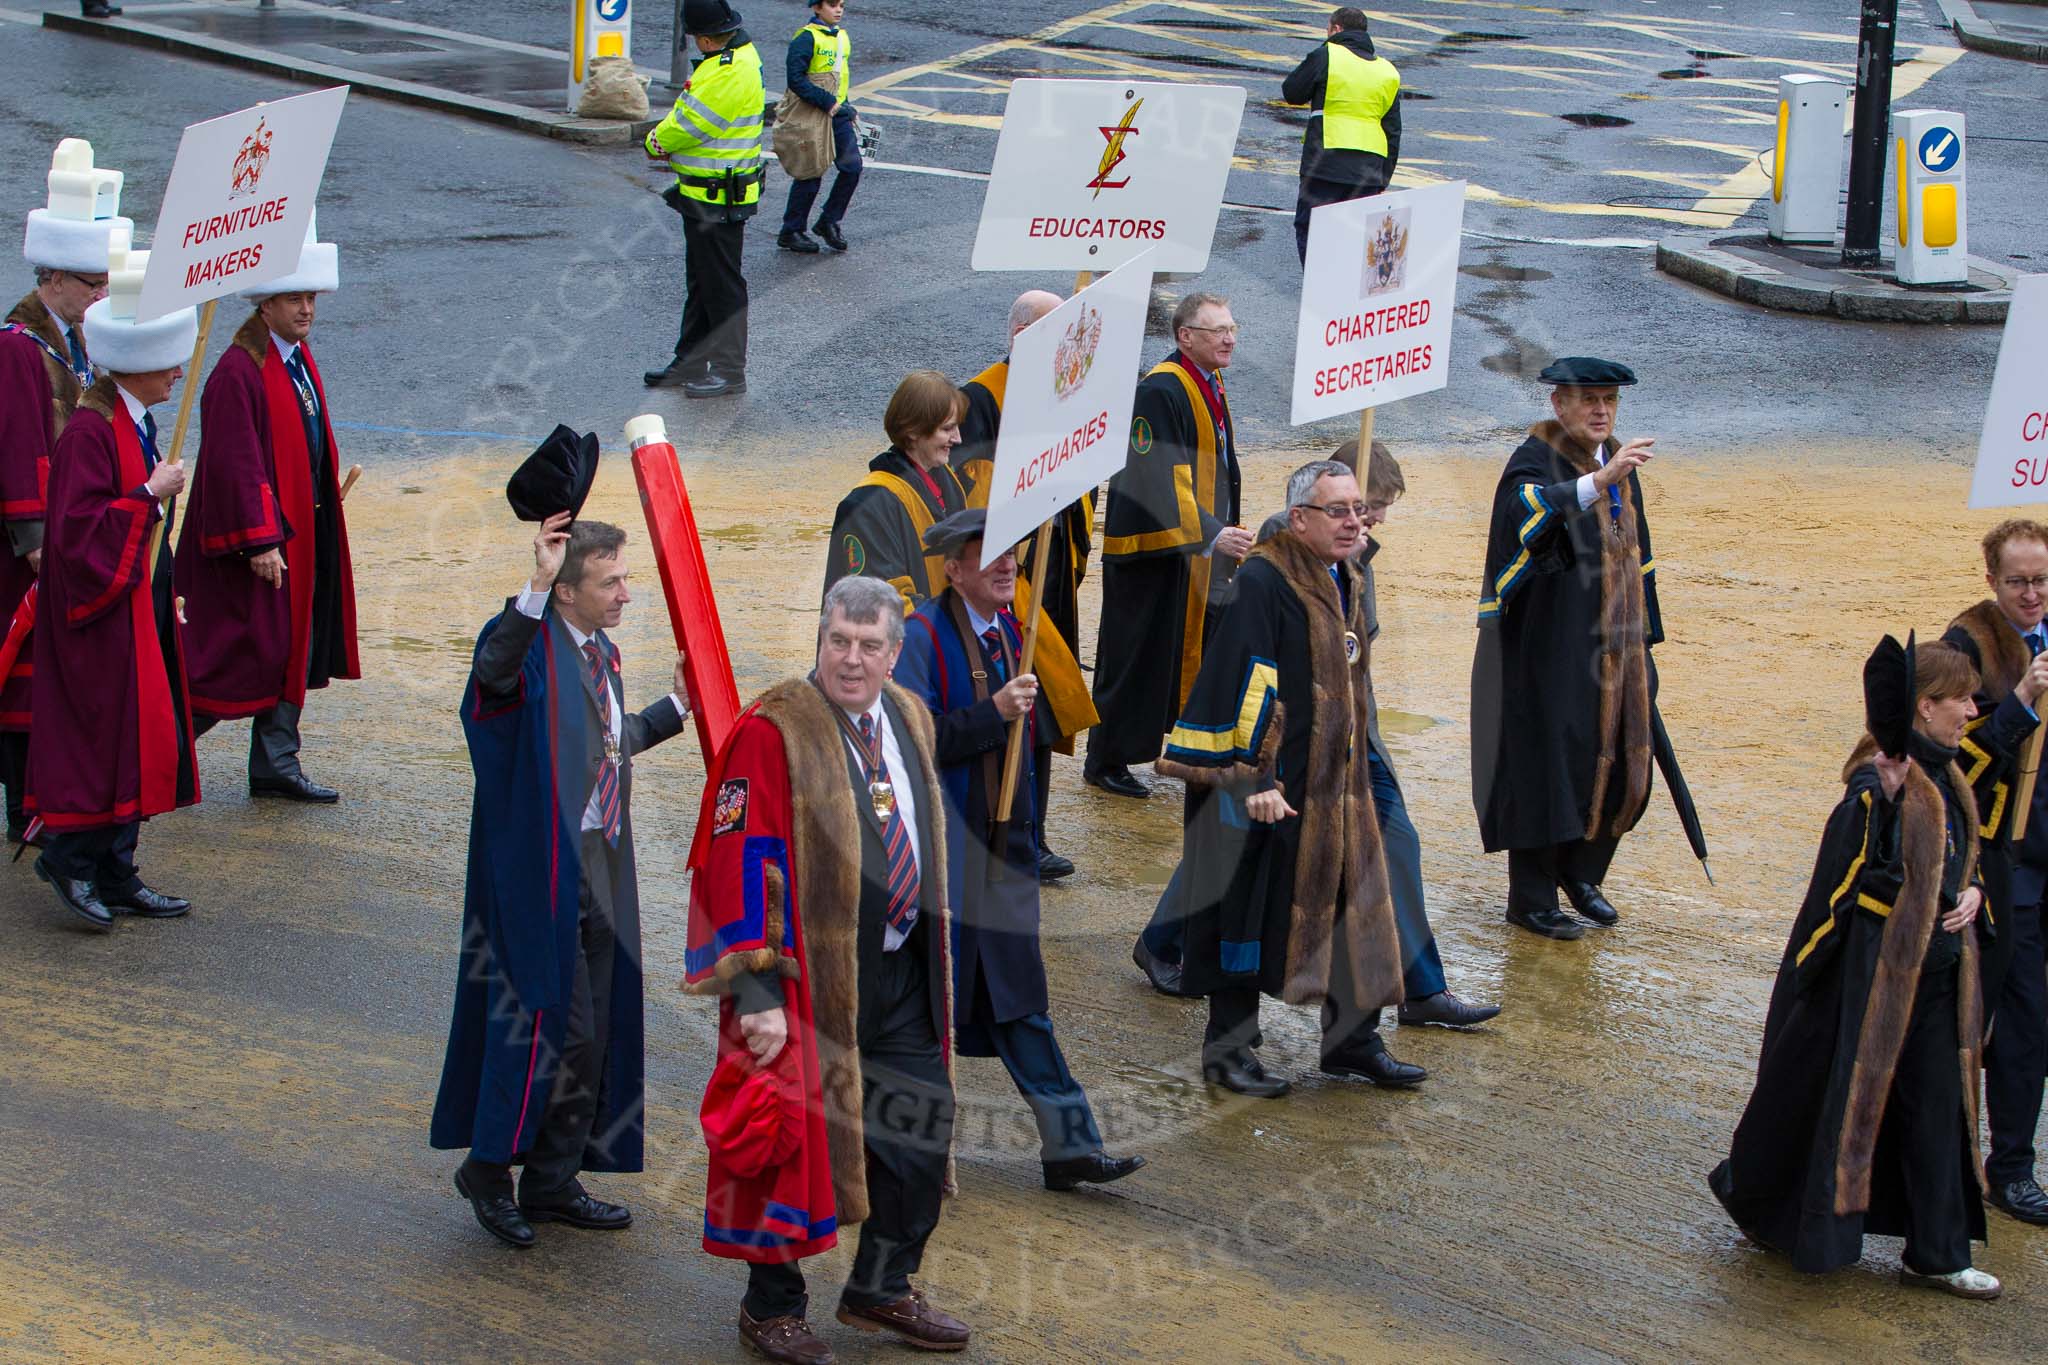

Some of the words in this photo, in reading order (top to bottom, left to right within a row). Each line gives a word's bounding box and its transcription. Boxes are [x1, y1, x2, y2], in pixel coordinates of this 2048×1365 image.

[183, 196, 288, 249] FURNITURE
[1029, 217, 1166, 240] EDUCATORS
[184, 243, 264, 288] MAKERS
[1325, 298, 1432, 346] CHARTERED
[1314, 345, 1433, 397] SECRETARIES
[1014, 411, 1108, 497] ACTUARIES
